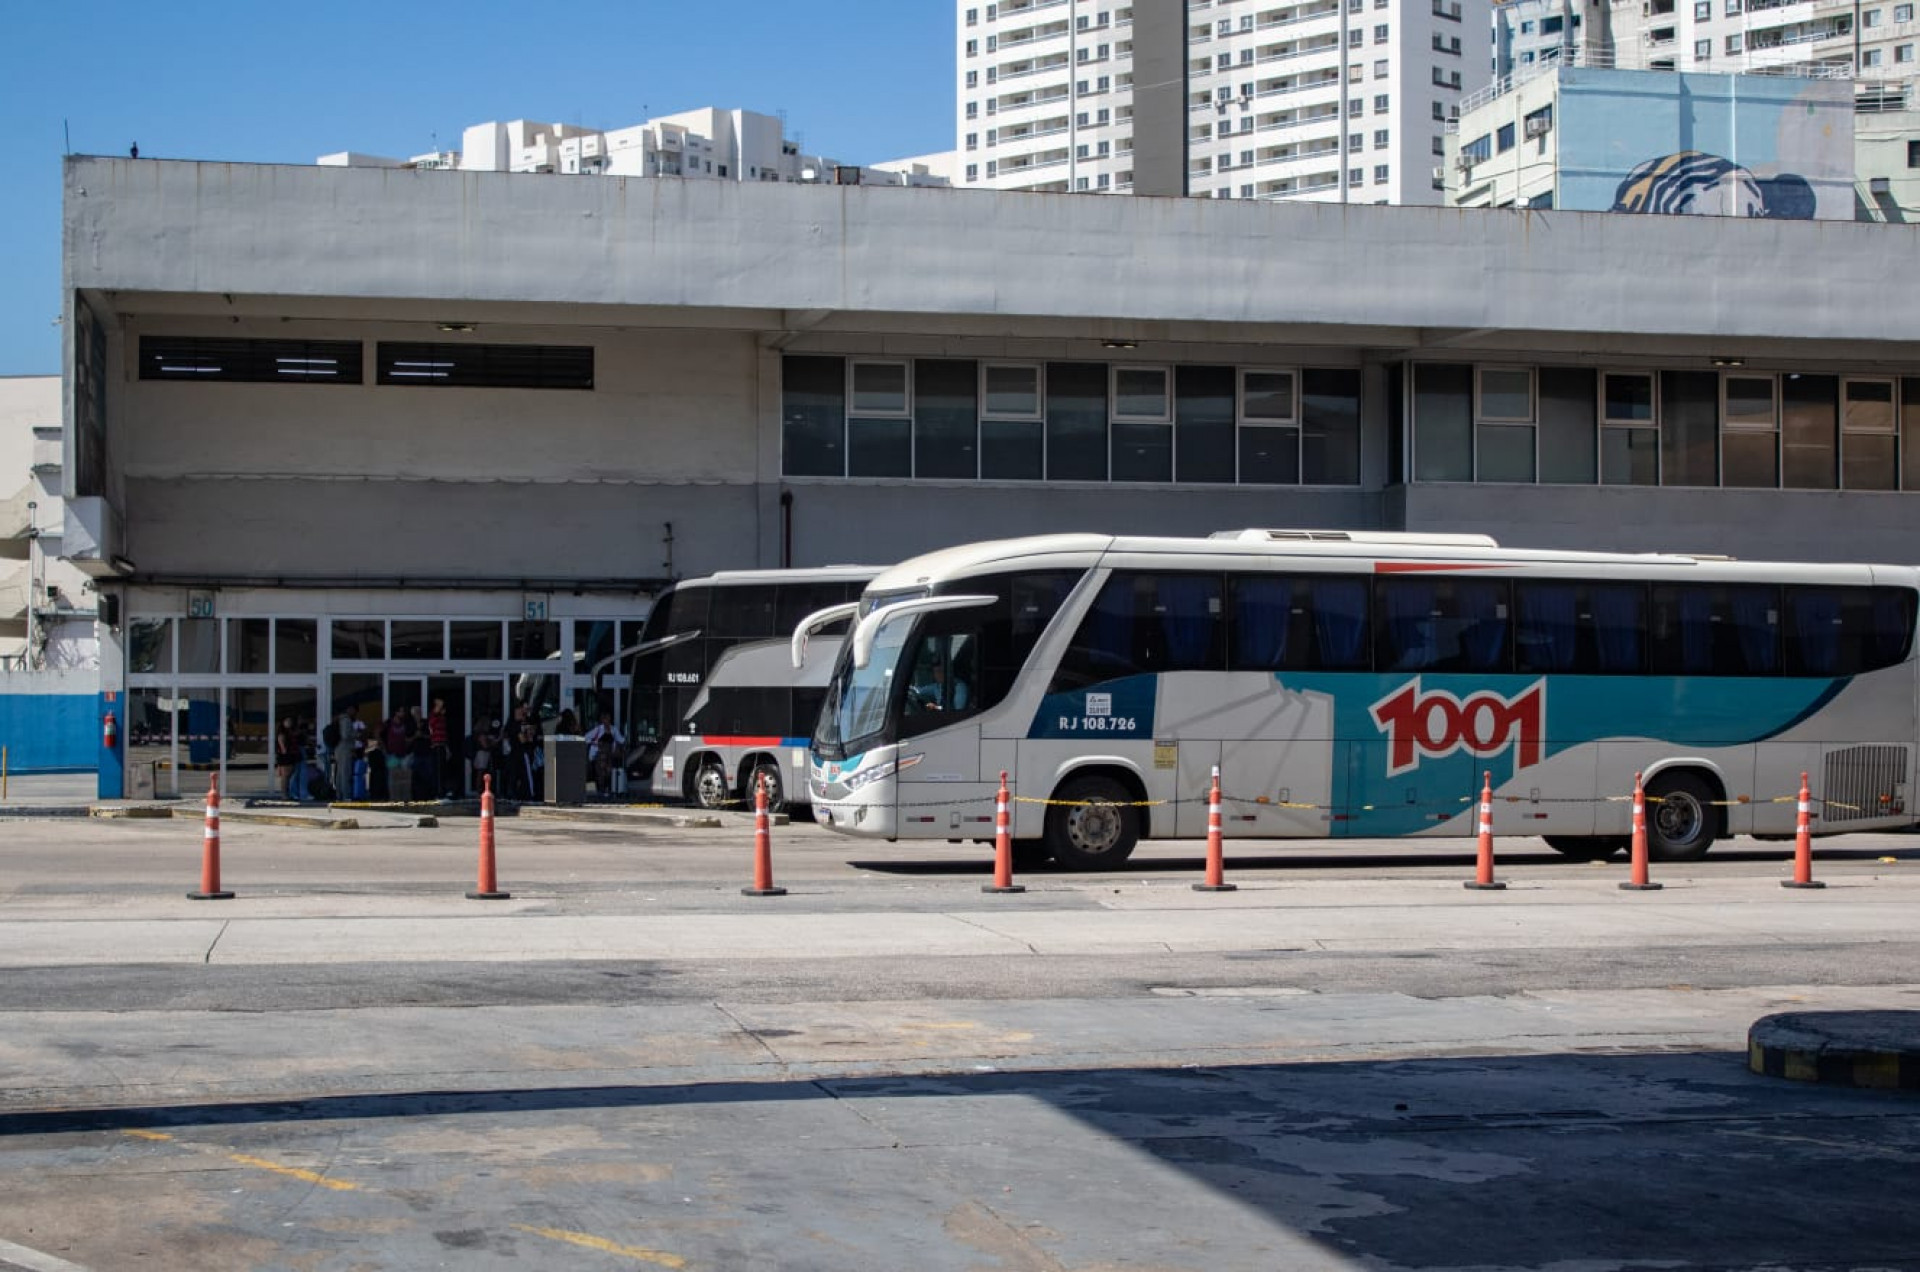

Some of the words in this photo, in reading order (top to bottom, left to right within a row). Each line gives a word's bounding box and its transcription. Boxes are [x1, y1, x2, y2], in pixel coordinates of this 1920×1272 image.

[191, 599, 213, 617] 50
[527, 601, 545, 618] 51
[1059, 717, 1078, 730] RJ
[1081, 717, 1136, 730] 108.726
[1369, 677, 1546, 777] 1001
